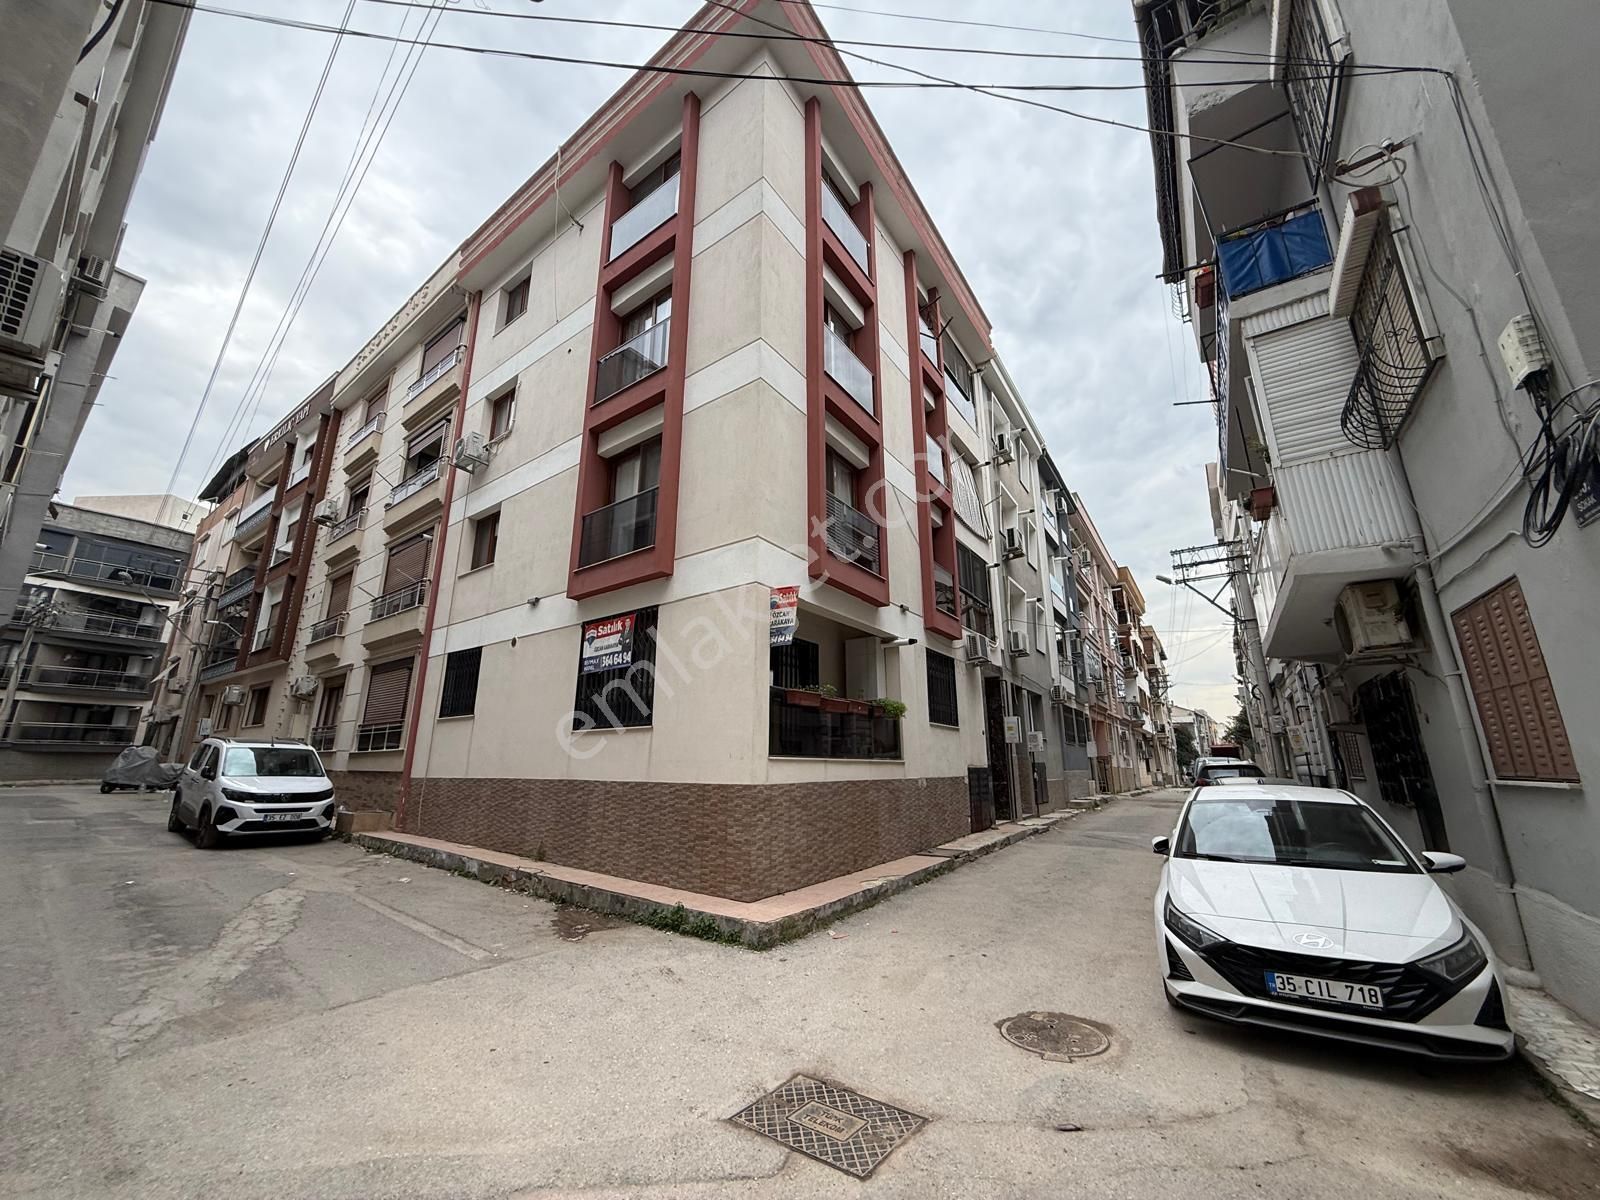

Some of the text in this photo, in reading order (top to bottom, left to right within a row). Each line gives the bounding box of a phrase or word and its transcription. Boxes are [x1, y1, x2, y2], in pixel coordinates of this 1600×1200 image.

[598, 620, 623, 635] Satılık
[770, 618, 794, 626] ARAKAYA
[1276, 975, 1297, 993] 35
[1305, 980, 1337, 999] CIL
[1345, 984, 1379, 1005] 718
[803, 1113, 846, 1134] TELEKOM
